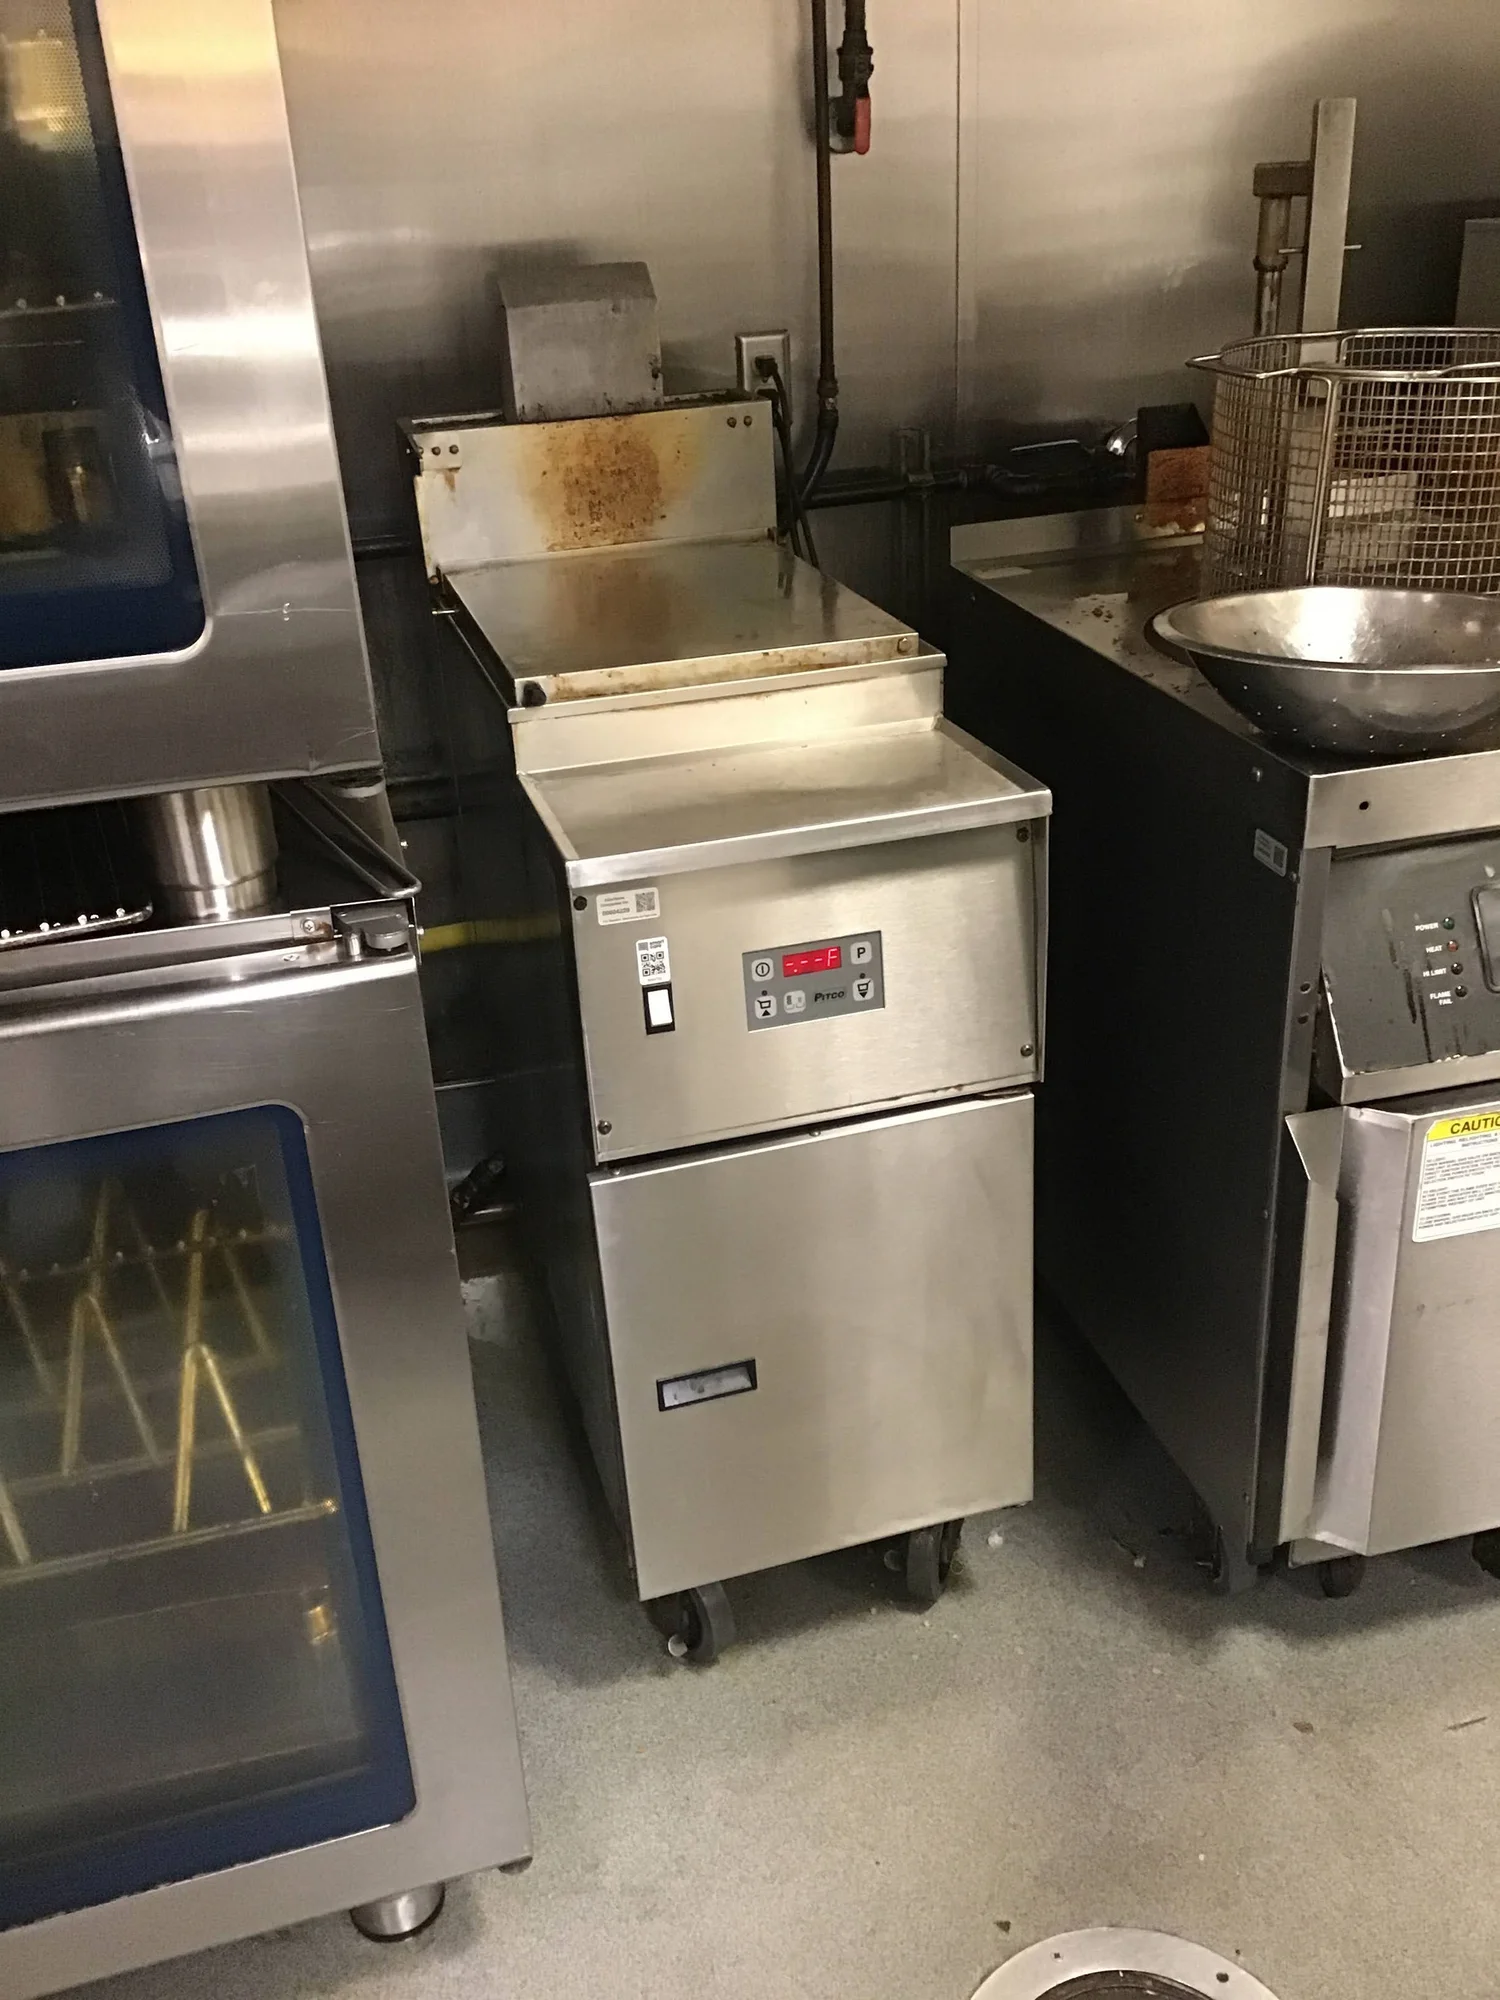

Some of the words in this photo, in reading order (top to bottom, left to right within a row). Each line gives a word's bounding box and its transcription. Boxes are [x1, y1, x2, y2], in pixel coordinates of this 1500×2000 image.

[1415, 922, 1438, 931] POWER
[857, 947, 866, 958] P
[814, 991, 845, 1002] PITCO
[1429, 990, 1451, 999] FLAME
